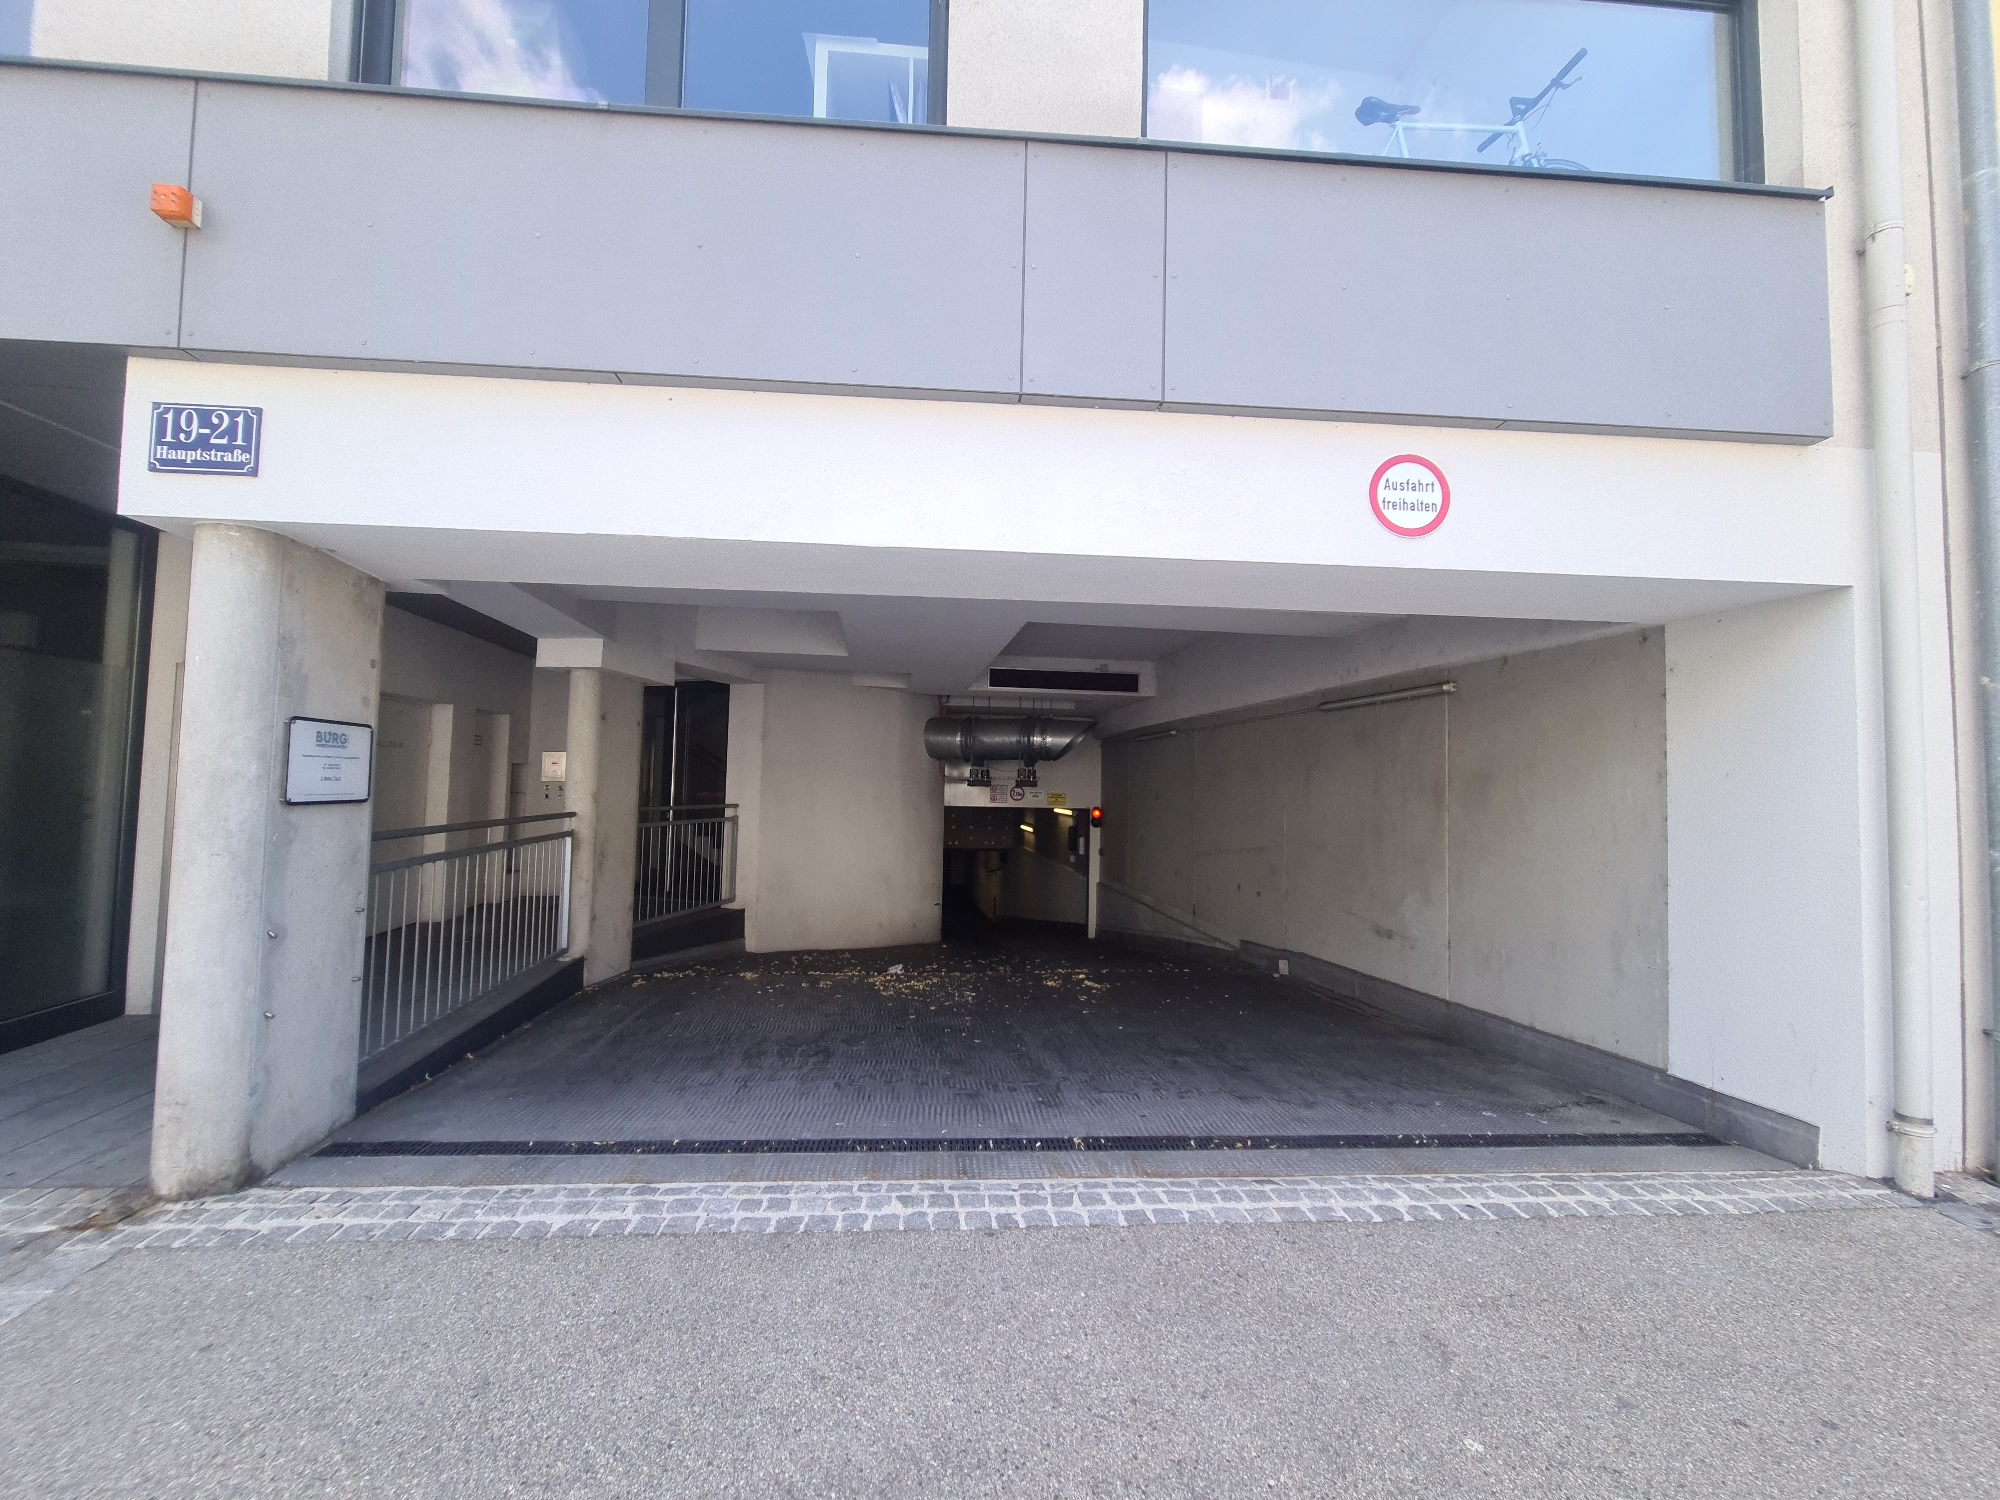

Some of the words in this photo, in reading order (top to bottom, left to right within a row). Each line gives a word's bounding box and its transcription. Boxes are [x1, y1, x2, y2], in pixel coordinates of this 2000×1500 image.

[160, 408, 247, 445] 19-21
[155, 445, 251, 464] Hauptstraße
[1383, 477, 1435, 493] Ausfahrt
[1382, 497, 1438, 513] freihalten
